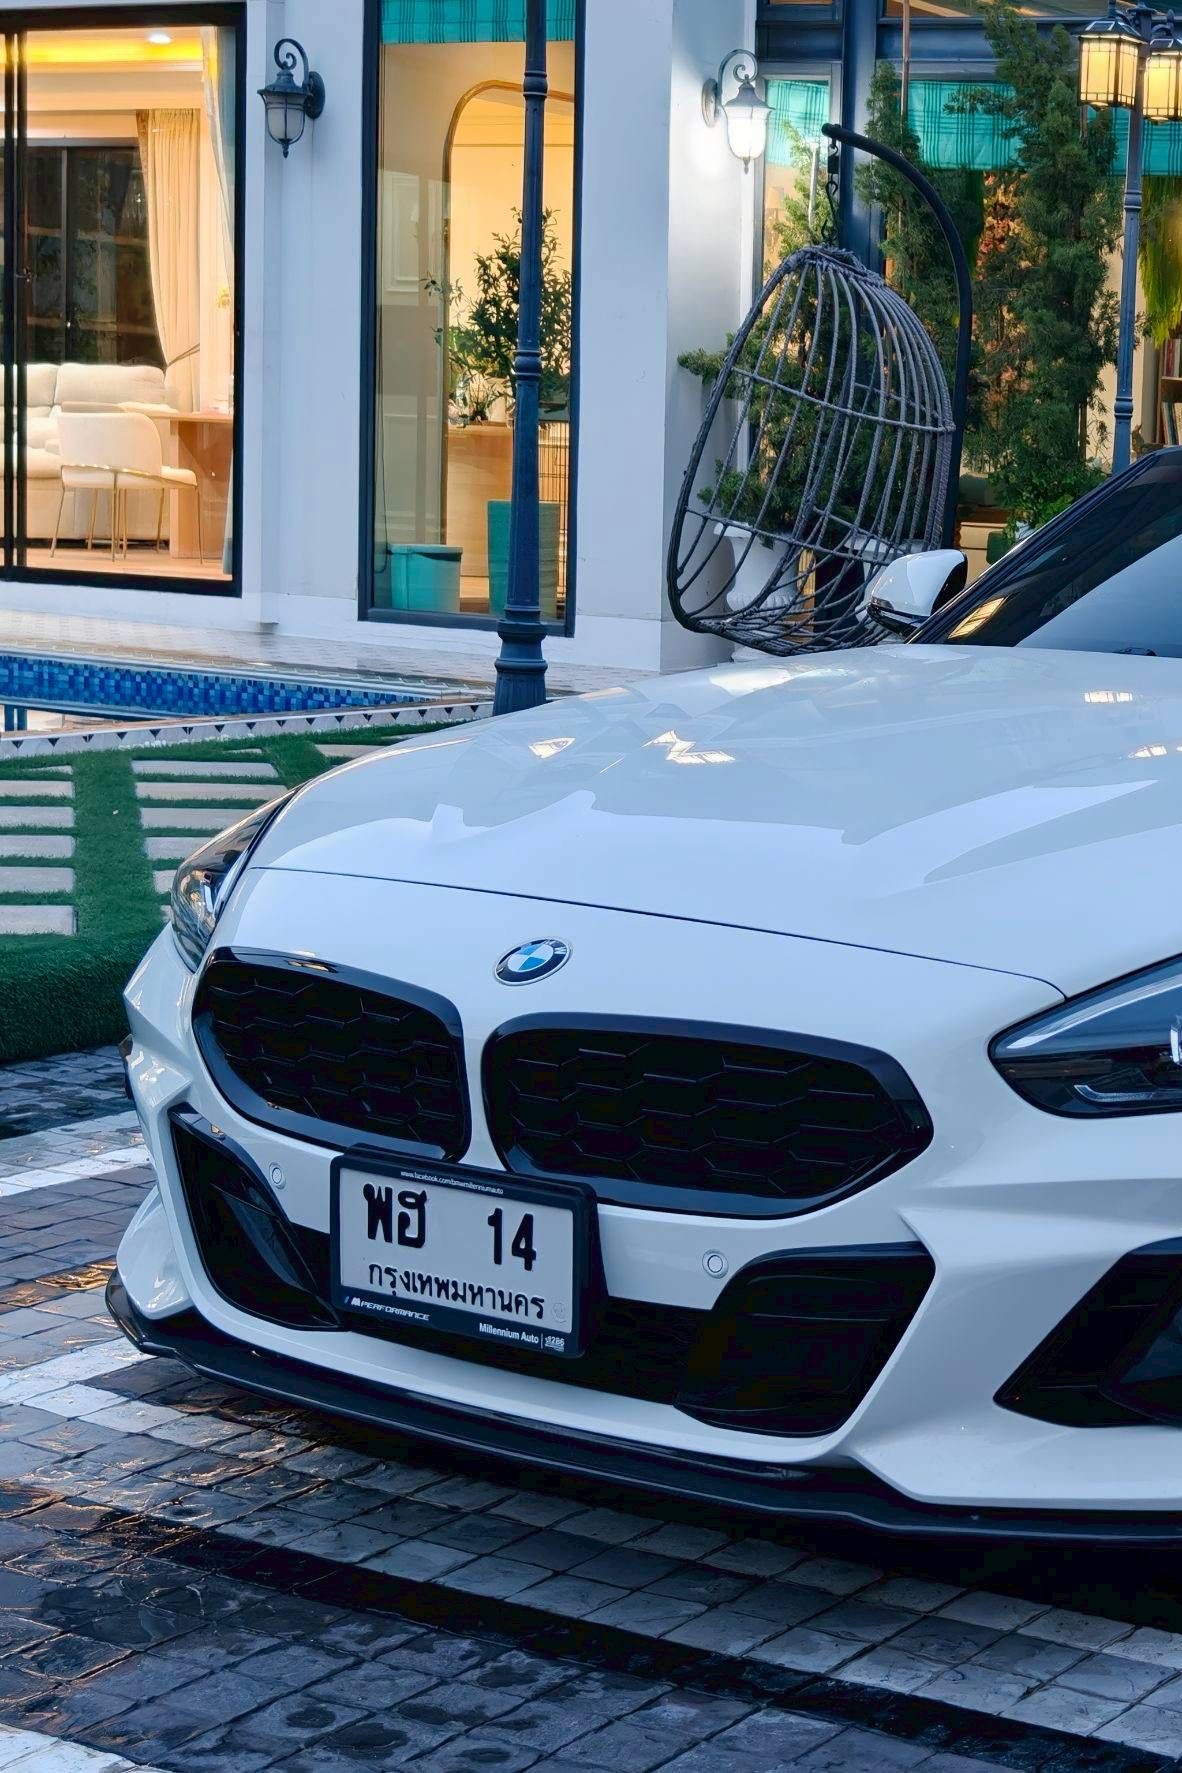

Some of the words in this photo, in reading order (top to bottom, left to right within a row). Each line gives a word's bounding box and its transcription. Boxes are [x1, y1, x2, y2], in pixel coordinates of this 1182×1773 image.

[363, 1183, 428, 1249] พฮ
[487, 1207, 537, 1271] 14
[360, 1300, 430, 1321] PERFORMANCE
[368, 1263, 545, 1319] กรุงเทพมหานคร
[479, 1322, 519, 1340] Millennium
[520, 1331, 539, 1344] Auto
